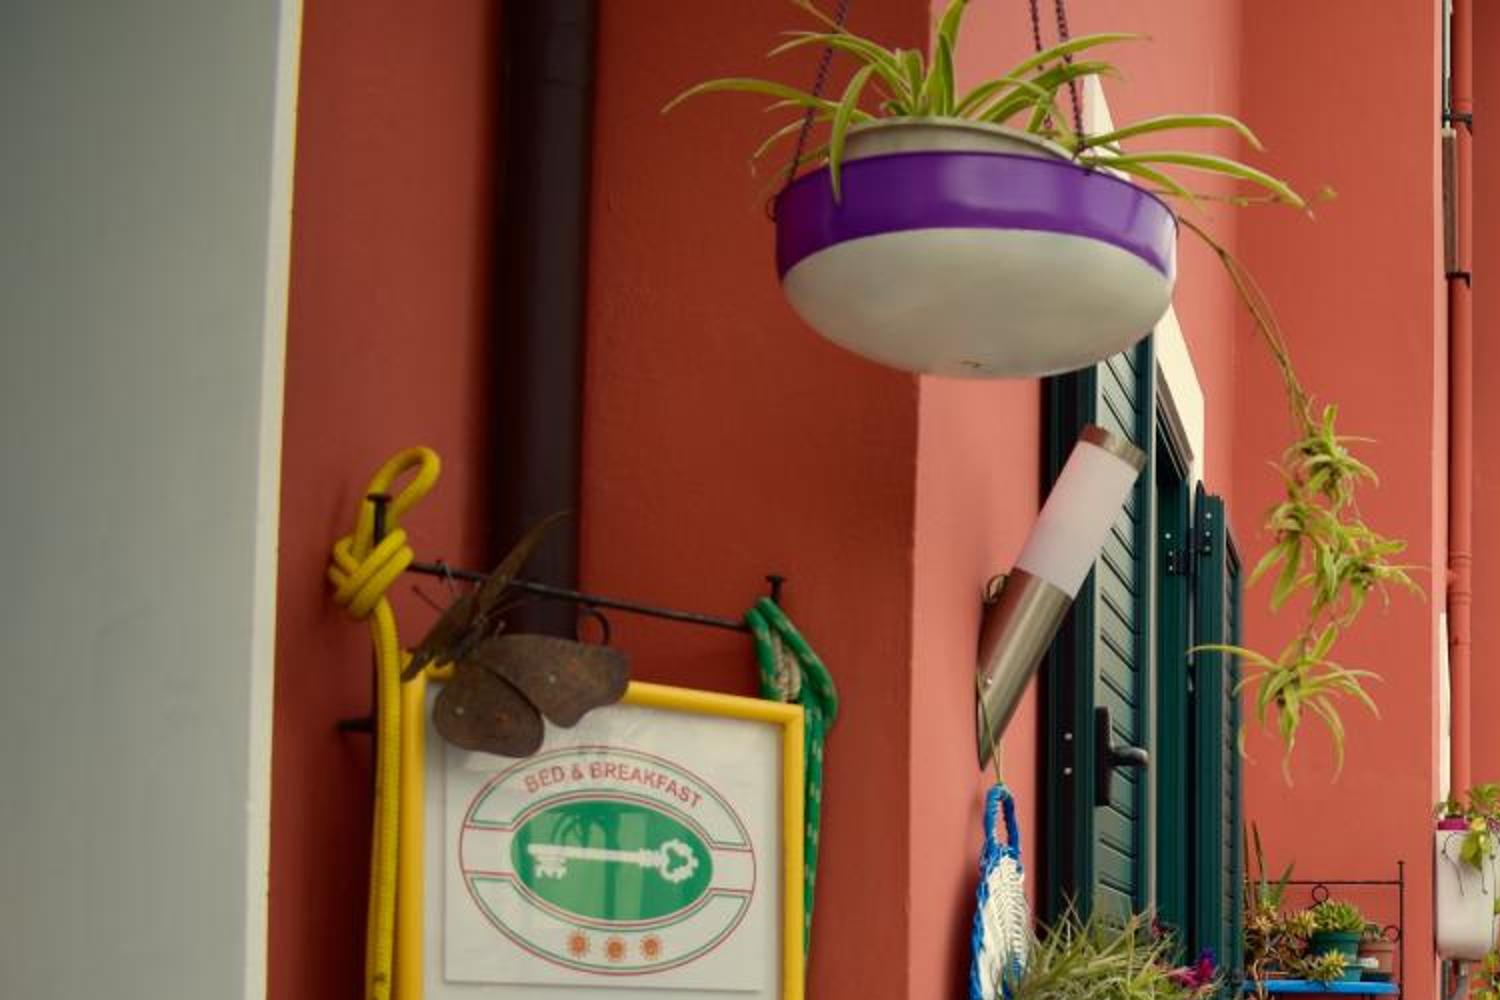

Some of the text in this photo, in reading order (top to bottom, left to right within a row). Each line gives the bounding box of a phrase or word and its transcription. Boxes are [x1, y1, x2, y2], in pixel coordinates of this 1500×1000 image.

[525, 762, 704, 809] BED & BREAKFAST
